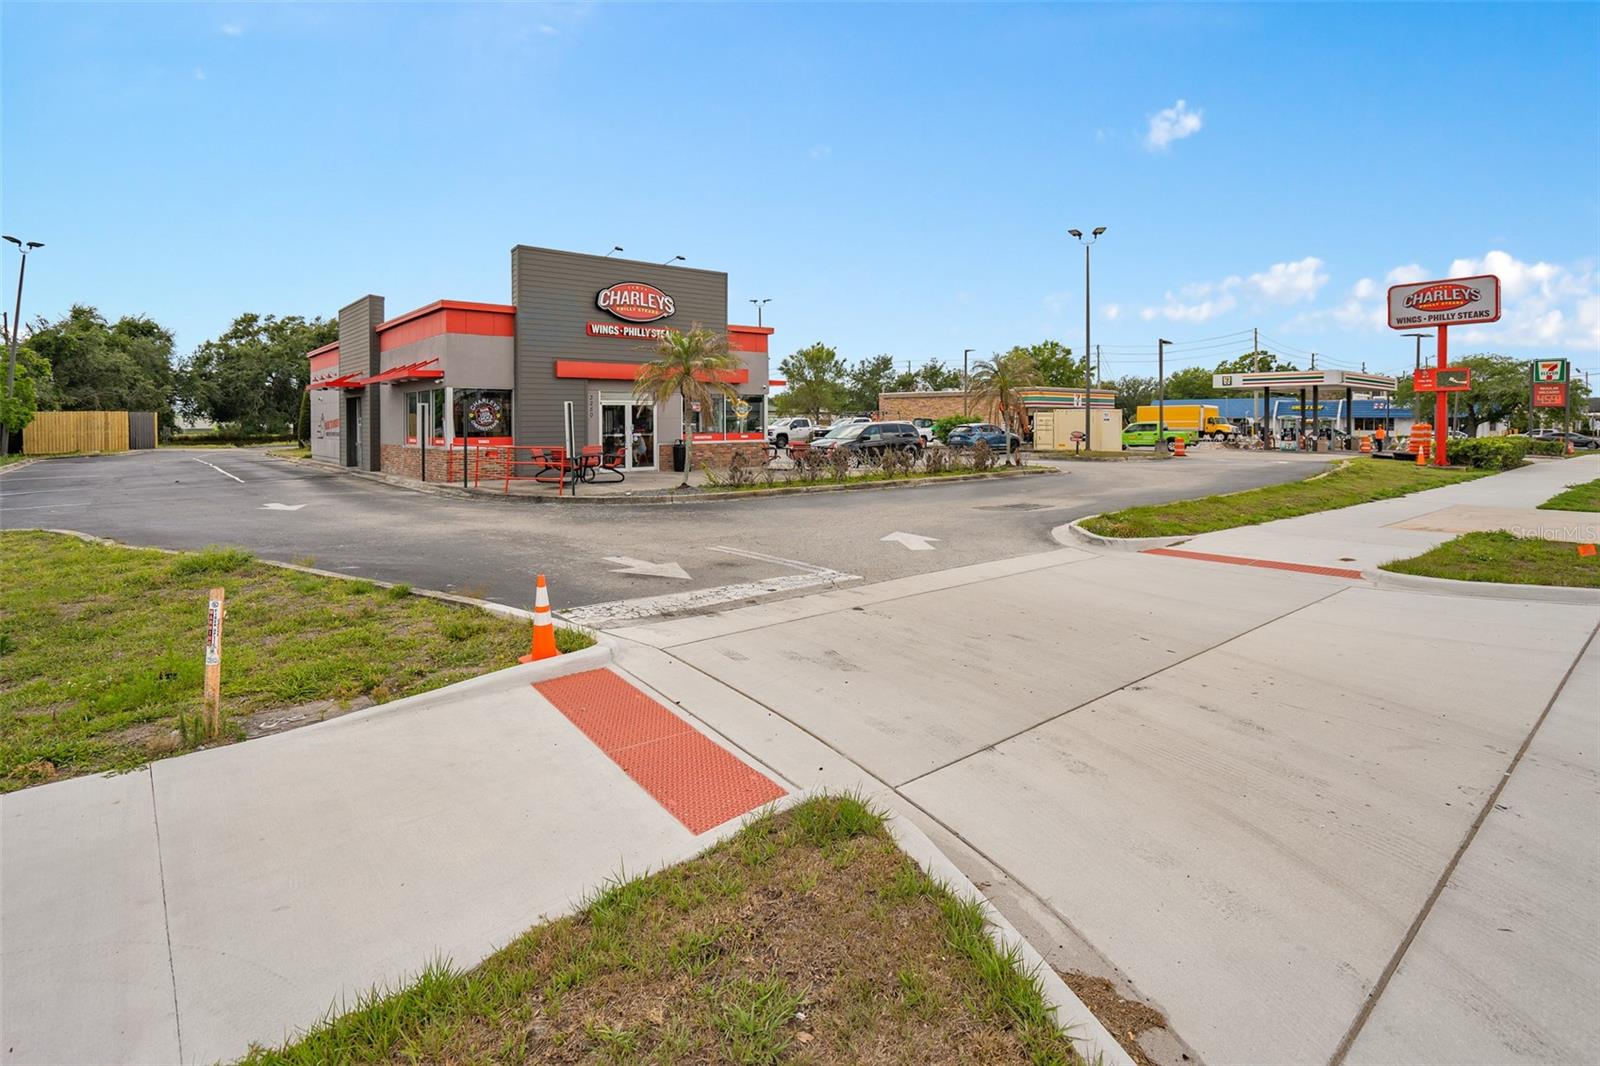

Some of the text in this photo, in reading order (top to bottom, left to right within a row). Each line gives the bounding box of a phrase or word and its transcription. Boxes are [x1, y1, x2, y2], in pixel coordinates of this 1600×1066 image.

[600, 290, 675, 313] CHARLEYS
[1403, 288, 1482, 308] CHARLEYS
[1396, 309, 1490, 325] WINGS PHILLY STEAKS
[591, 323, 680, 339] WINGS PHILLY STEA
[1541, 363, 1559, 380] 7
